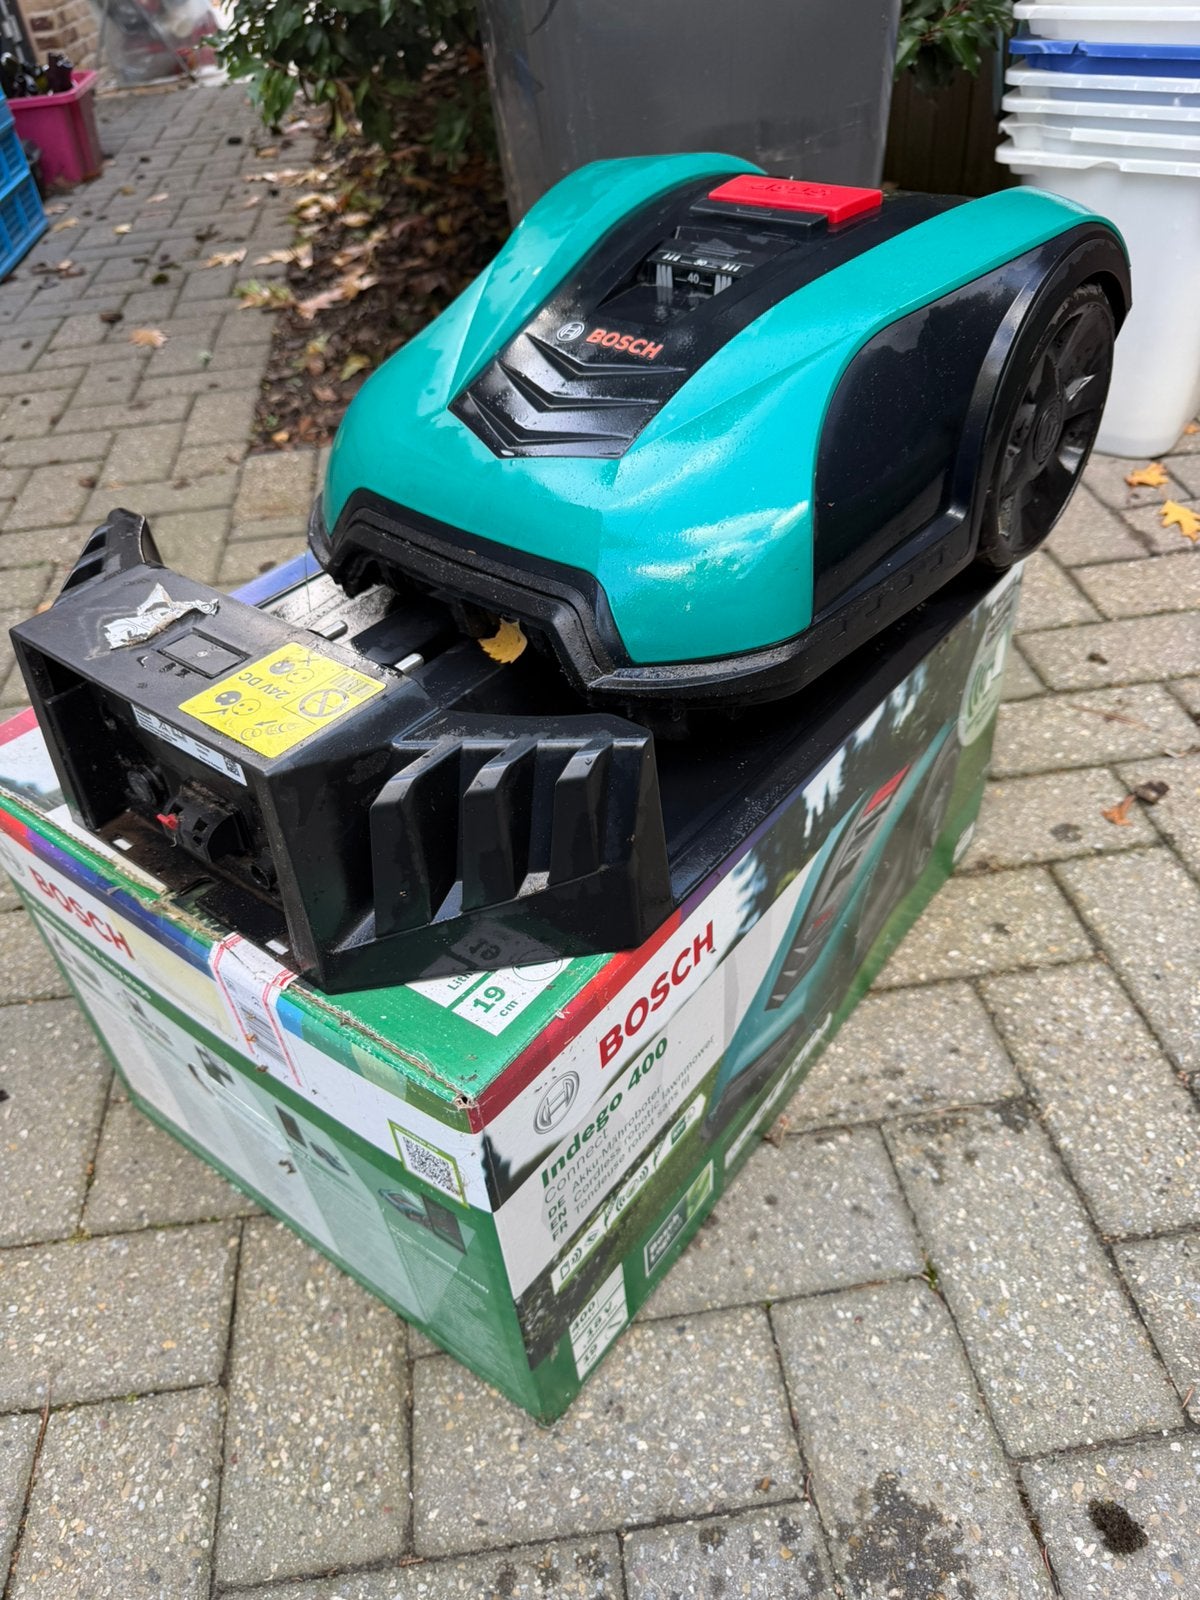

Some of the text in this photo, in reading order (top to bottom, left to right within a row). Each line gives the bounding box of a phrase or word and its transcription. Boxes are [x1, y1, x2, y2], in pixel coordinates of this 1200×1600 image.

[687, 272, 700, 284] 40
[585, 328, 664, 361] BOSCH
[238, 672, 290, 700] 24V DC
[28, 865, 136, 960] BOSCH
[473, 985, 506, 1014] 19
[499, 1000, 519, 1017] cm
[599, 919, 714, 1069] BOSCH
[541, 1037, 668, 1189] Indego 400
[544, 1128, 608, 1203] Connect
[550, 1207, 567, 1231] EN
[573, 1148, 622, 1202] Cordless
[624, 1099, 660, 1145] robotic
[548, 1195, 566, 1220] DE
[552, 1220, 568, 1242] FR
[573, 1153, 626, 1214] Tondeuse
